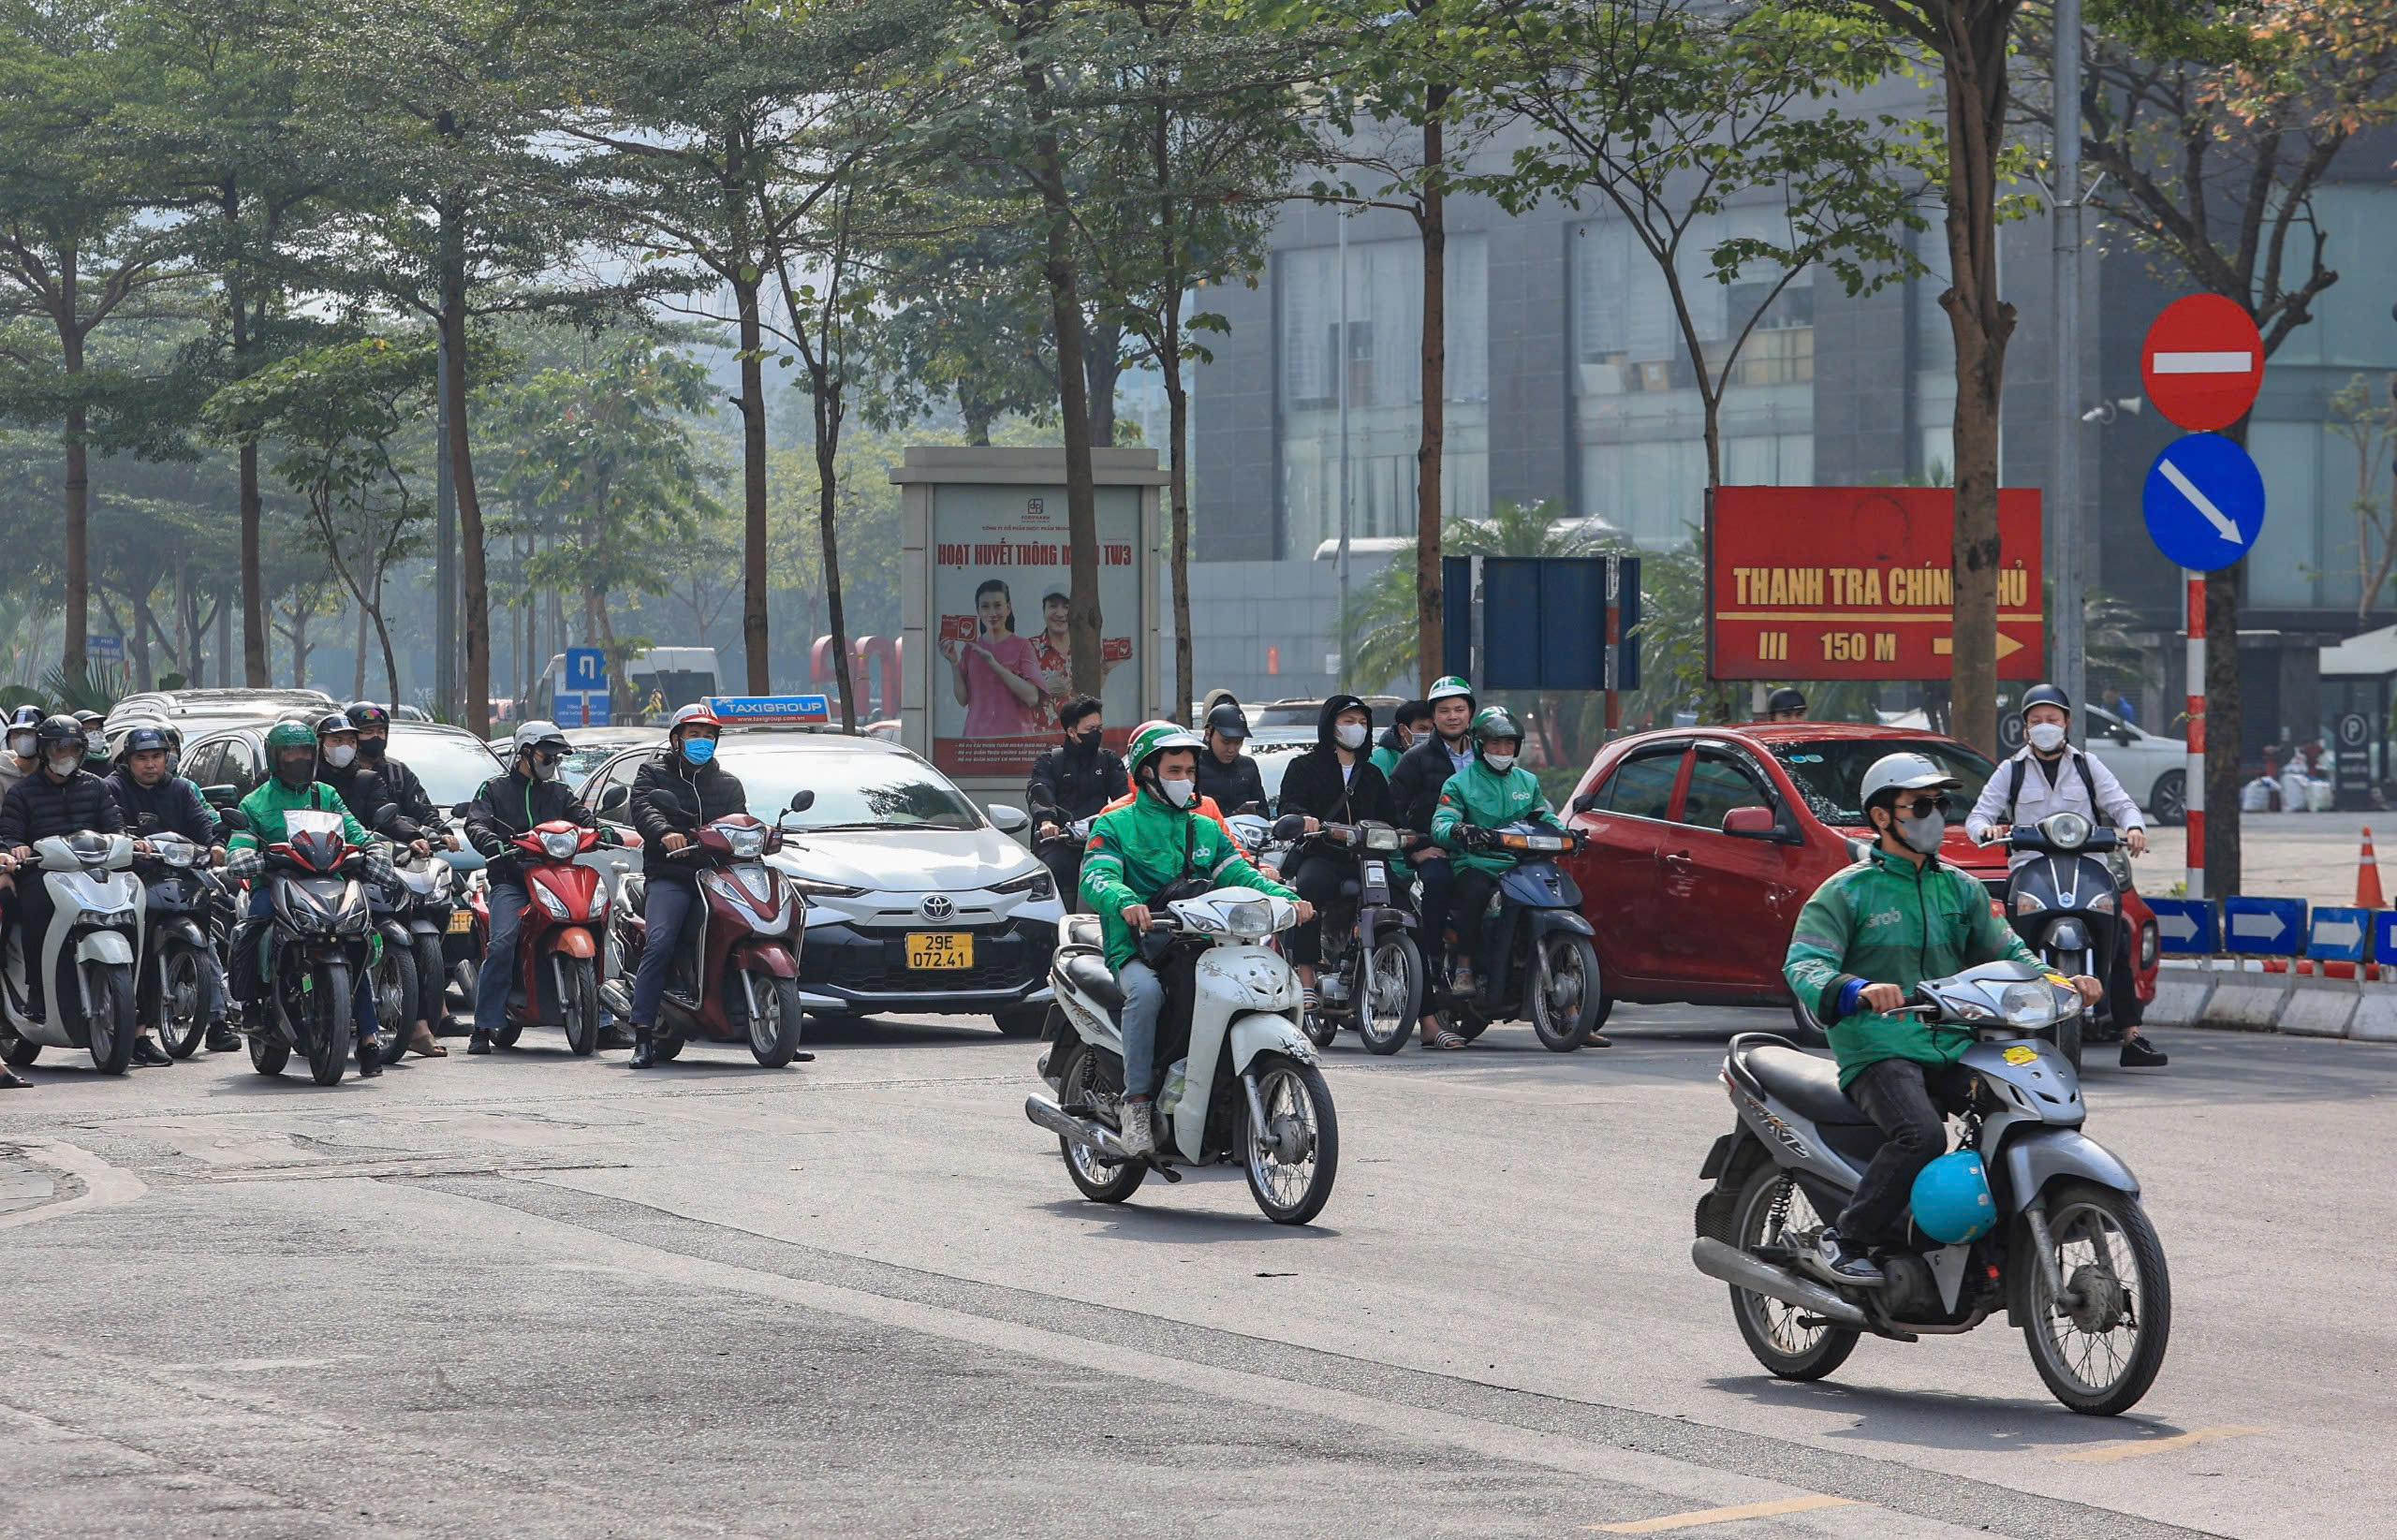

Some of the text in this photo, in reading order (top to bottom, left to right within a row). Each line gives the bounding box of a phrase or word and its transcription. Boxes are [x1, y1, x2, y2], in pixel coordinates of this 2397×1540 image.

[937, 544, 971, 570] HOẠT
[974, 536, 1014, 565] HUYẾT
[1016, 540, 1057, 565] THÔNG
[1104, 544, 1132, 565] TW3
[1733, 559, 2027, 607] THANH TRA CHÍN HỦ
[1820, 632, 1867, 661] 150
[1875, 633, 1896, 661] M
[726, 702, 822, 713] TAXIGROUP
[1192, 844, 1211, 859] rab
[925, 935, 954, 950] 29E
[913, 951, 963, 967] 072.41
